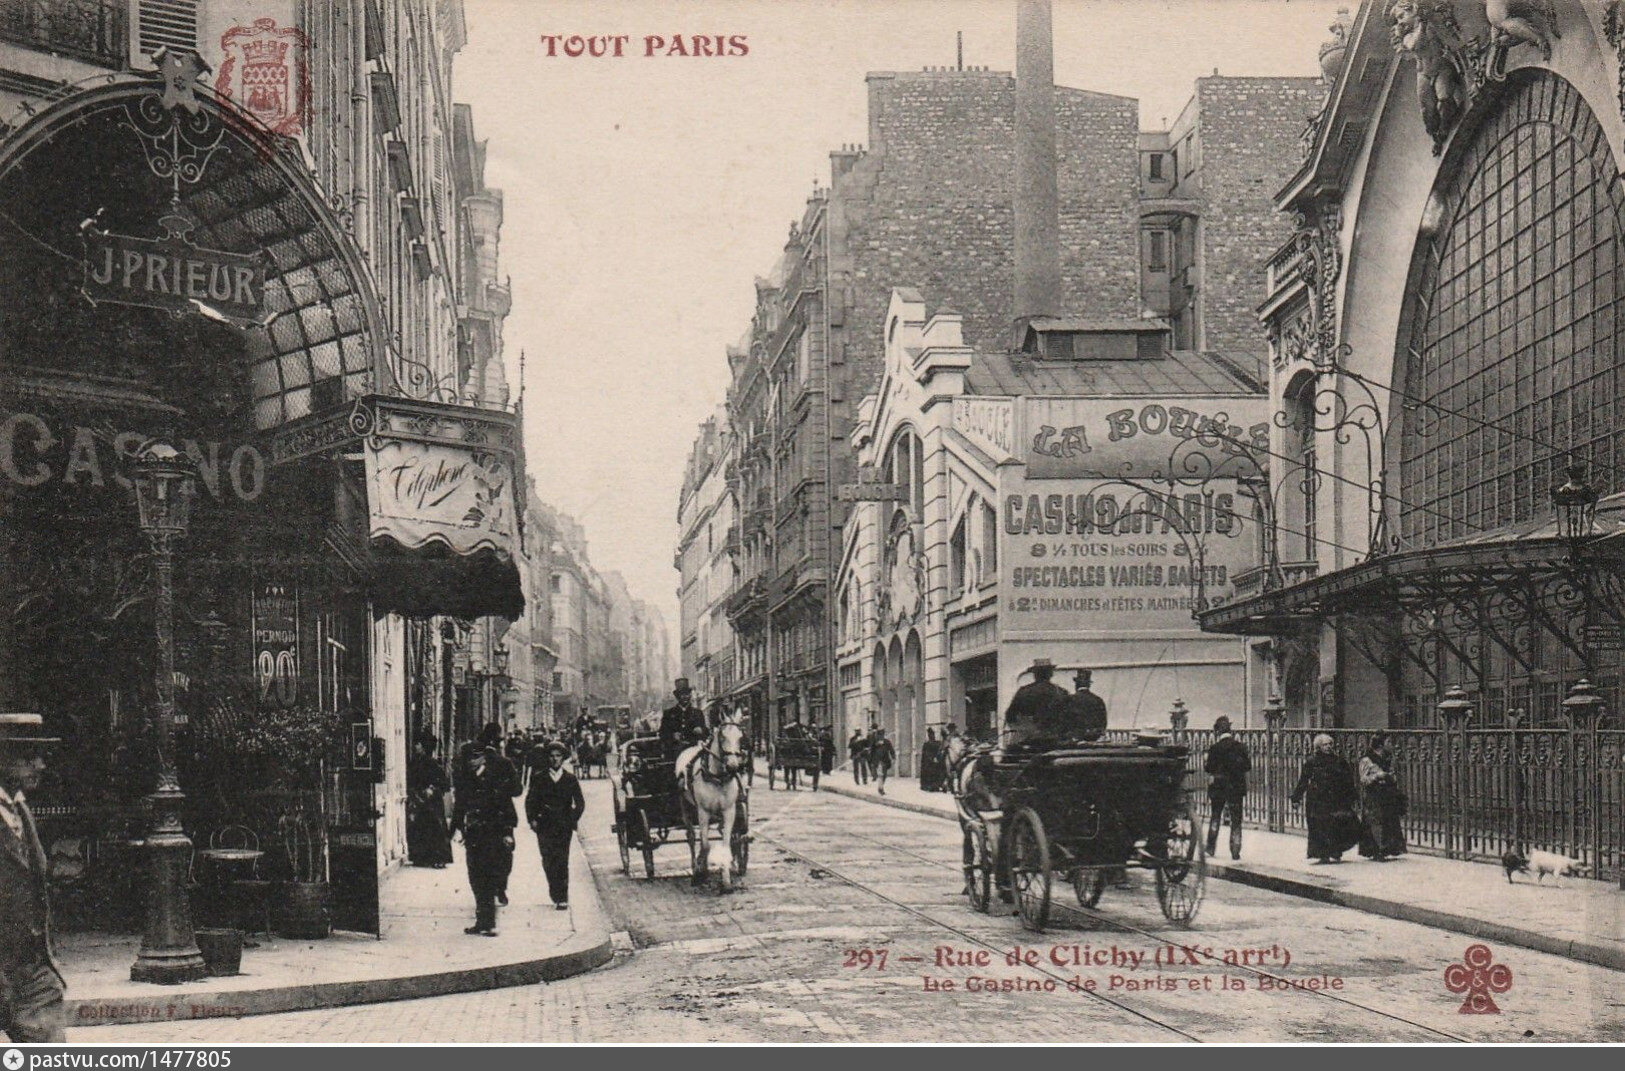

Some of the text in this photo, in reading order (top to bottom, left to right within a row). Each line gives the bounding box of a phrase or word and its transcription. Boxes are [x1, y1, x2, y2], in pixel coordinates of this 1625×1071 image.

[1033, 404, 1270, 458] LA BOUCLE
[0, 412, 265, 503] CASNO
[1004, 493, 1116, 535] CASINO
[1145, 493, 1234, 535] PARIS
[1030, 543, 1047, 557] 8
[1070, 543, 1108, 557] TOUS
[1110, 544, 1126, 557] les
[1127, 543, 1168, 557] SOIRS
[1173, 543, 1187, 556] 8
[1012, 565, 1105, 588] SPECTACLES
[1040, 597, 1100, 612] DIMANCHES
[255, 629, 296, 644] PERNOD
